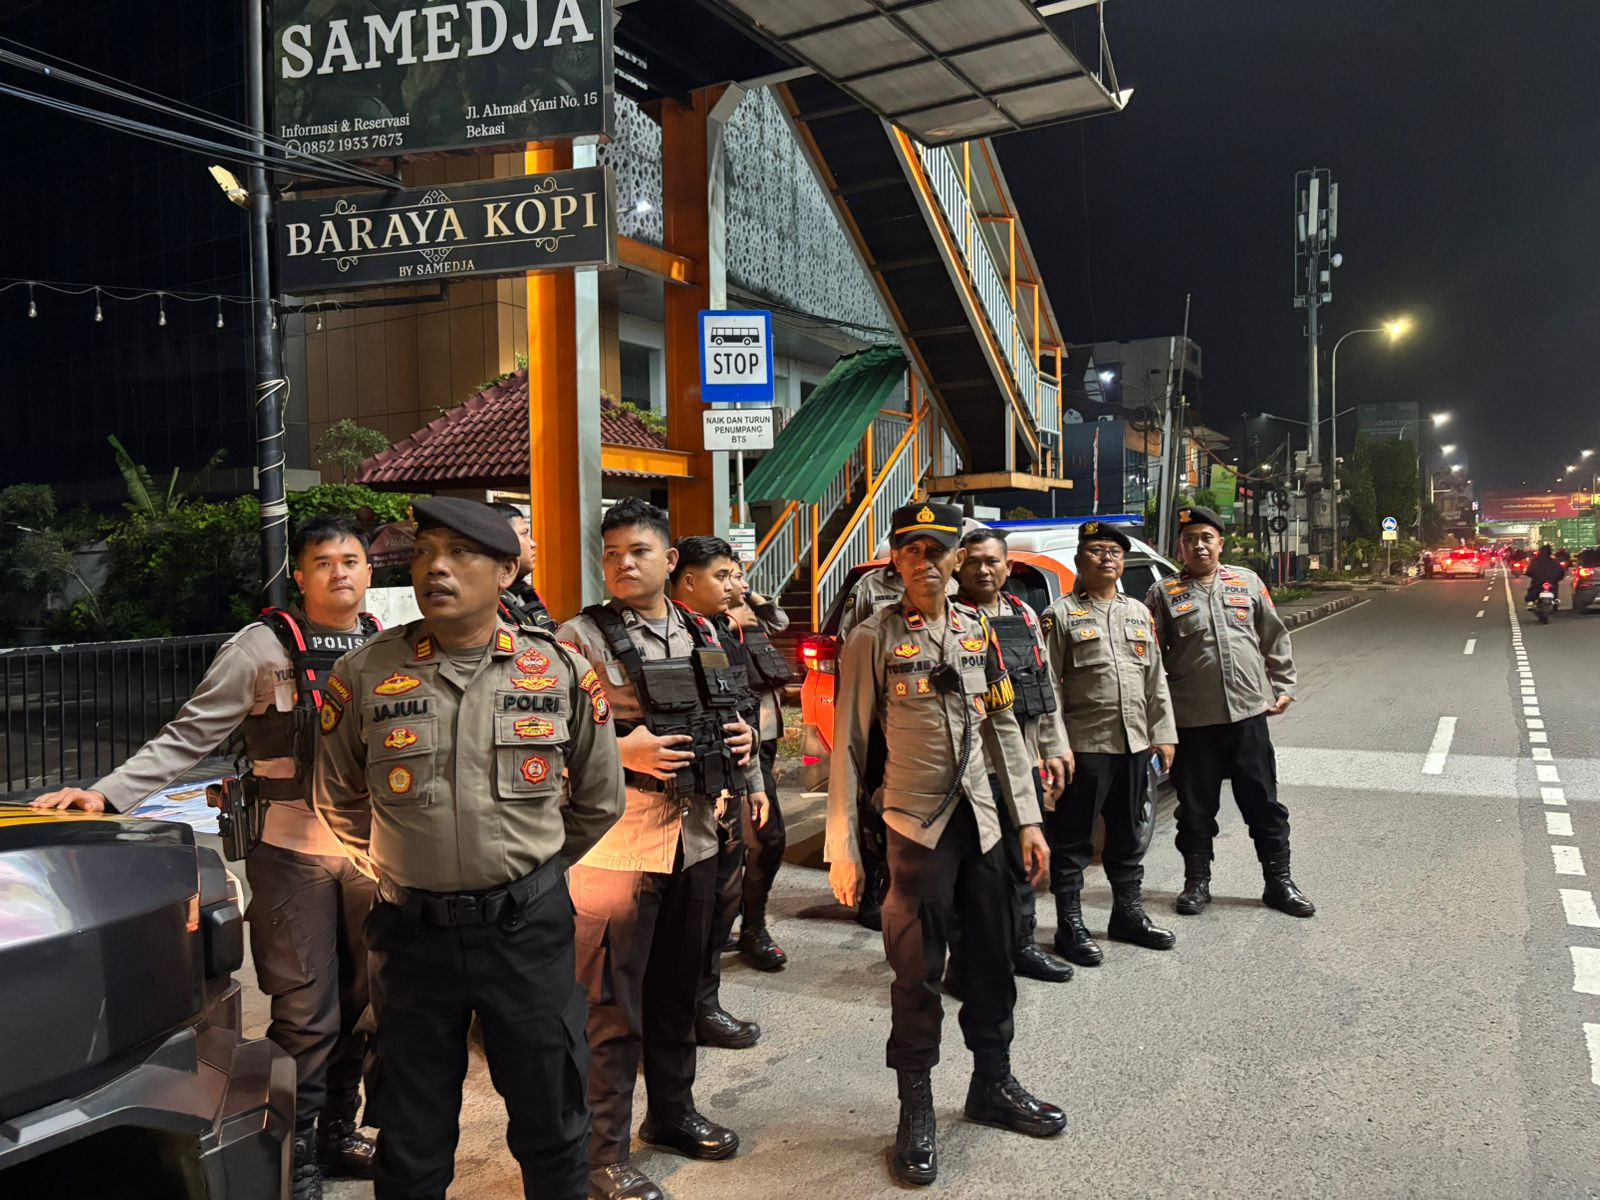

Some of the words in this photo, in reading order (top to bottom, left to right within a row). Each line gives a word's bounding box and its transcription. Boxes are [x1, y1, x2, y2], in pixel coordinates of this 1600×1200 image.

[281, 0, 593, 79] SAMEDJA
[465, 106, 479, 119] Jl.
[482, 100, 527, 117] Ahmad
[529, 96, 557, 111] Yani
[559, 95, 580, 108] No.
[583, 91, 598, 106] 15
[281, 120, 338, 138] Informasi
[341, 119, 351, 132] &
[354, 113, 410, 131] Reservasi
[466, 121, 506, 138] Bekasi
[302, 139, 335, 155] 0852
[338, 136, 369, 151] 1933
[371, 133, 403, 148] 7673
[286, 207, 468, 257] BARAYA
[483, 192, 598, 239] KOPI
[399, 265, 413, 277] BY
[416, 259, 475, 276] SAMEDJA
[713, 352, 759, 375] STOP
[706, 416, 725, 424] NAIK
[726, 416, 743, 424] DAN
[744, 415, 770, 424] TURUN
[715, 425, 763, 434] PENUMPANG
[731, 435, 747, 443] BTS
[1171, 592, 1191, 604] ATO
[1224, 586, 1249, 594] POLRI
[312, 636, 369, 650] POLIS
[373, 699, 428, 723] JAJULI
[503, 694, 560, 713] POLRI
